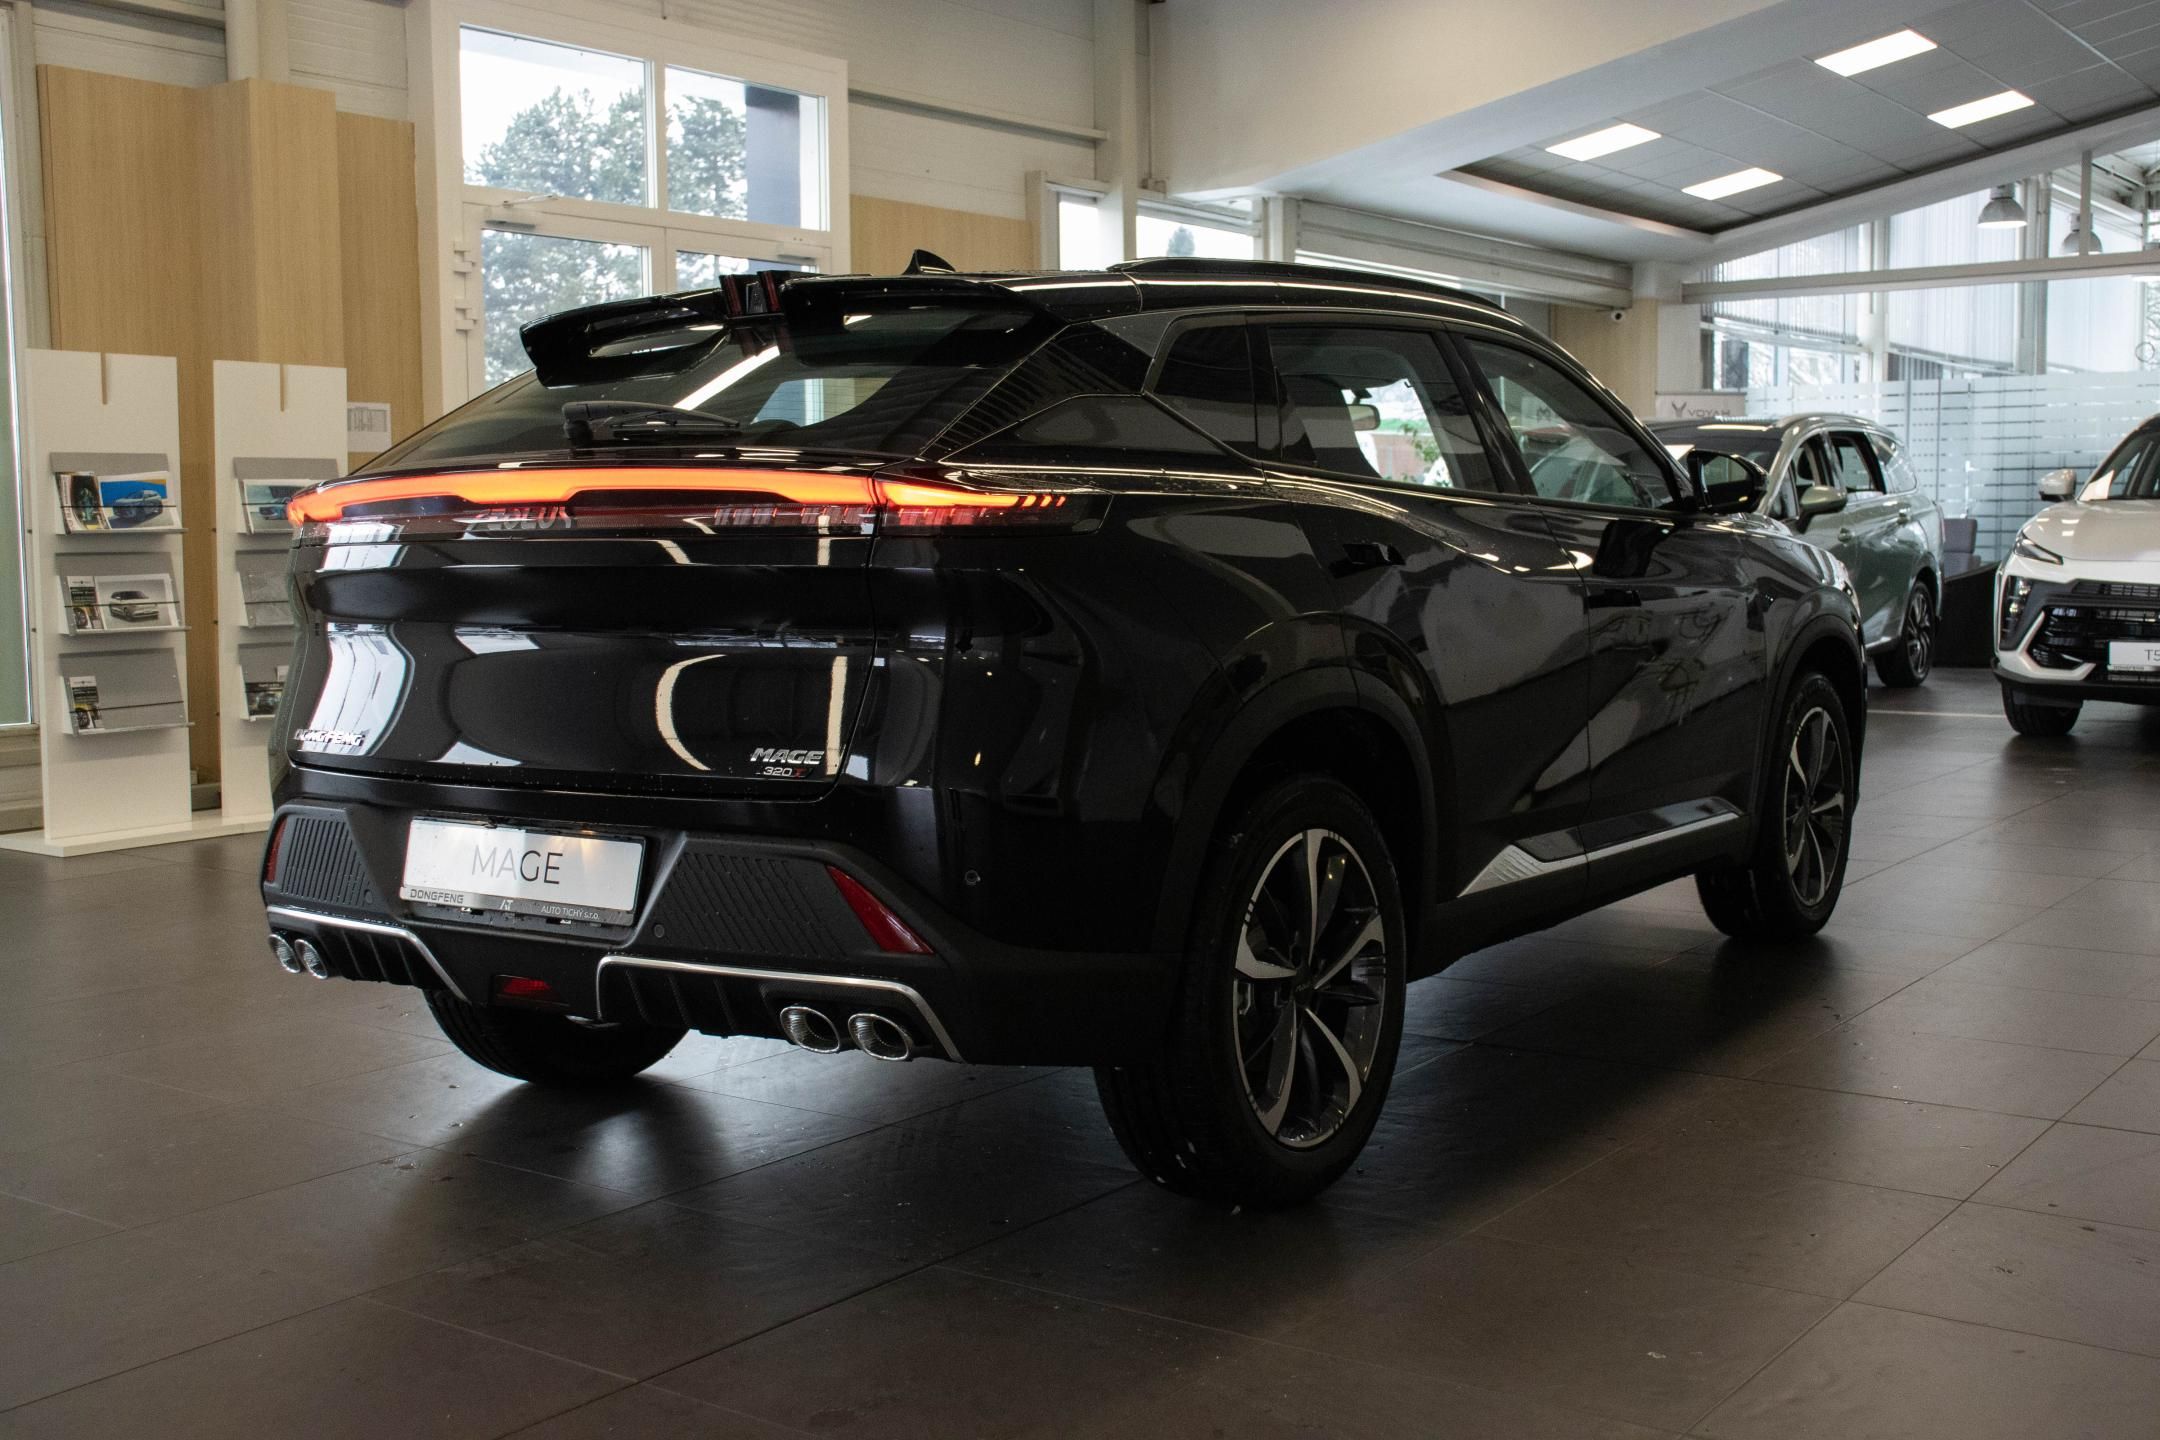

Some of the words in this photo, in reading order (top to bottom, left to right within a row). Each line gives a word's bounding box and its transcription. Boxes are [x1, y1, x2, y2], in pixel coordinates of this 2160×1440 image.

[1688, 409, 1731, 417] VOYAH
[749, 747, 825, 765] MAGE
[471, 844, 563, 885] MAGE
[410, 888, 465, 904] DONGFENG
[541, 905, 561, 915] AUTO
[562, 907, 584, 917] TICHÝ
